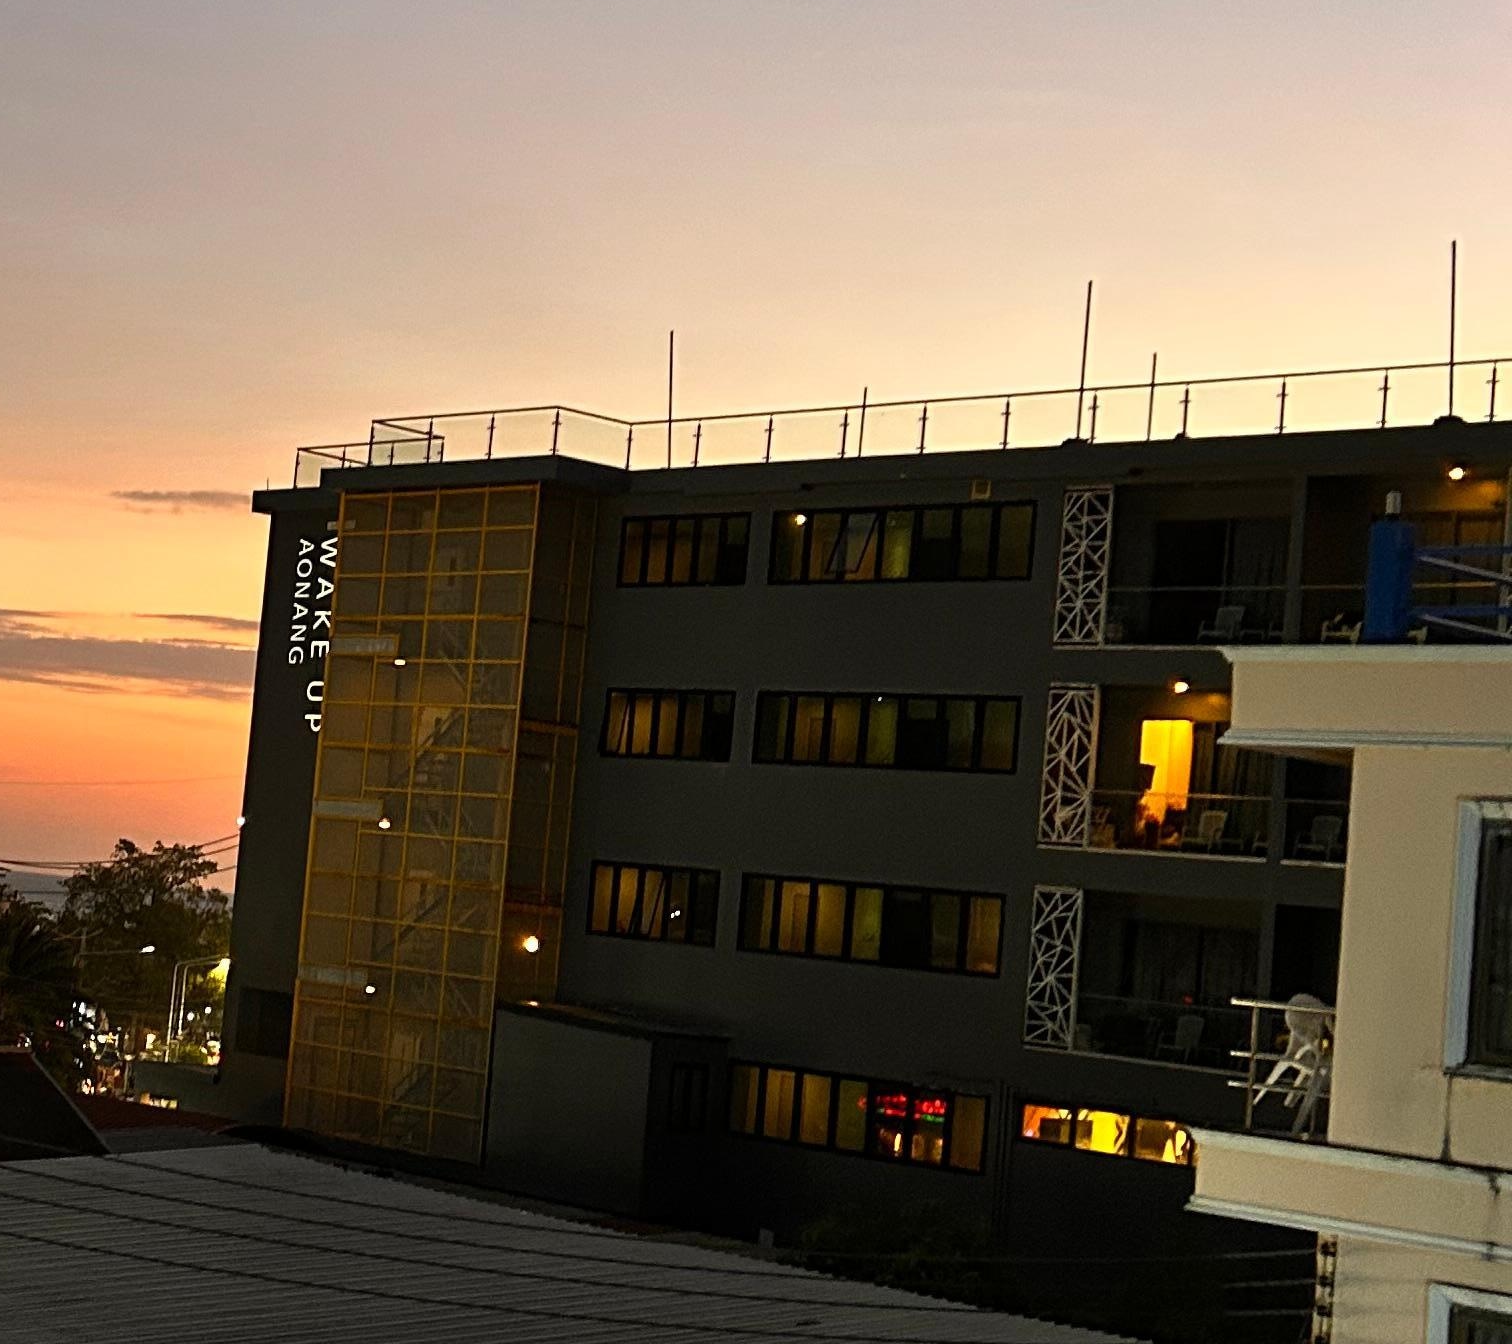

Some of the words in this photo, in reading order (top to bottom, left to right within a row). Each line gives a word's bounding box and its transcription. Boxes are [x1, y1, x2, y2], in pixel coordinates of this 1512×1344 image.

[288, 538, 315, 665] AONANG
[310, 537, 338, 658] WAKE
[304, 680, 325, 732] UP
